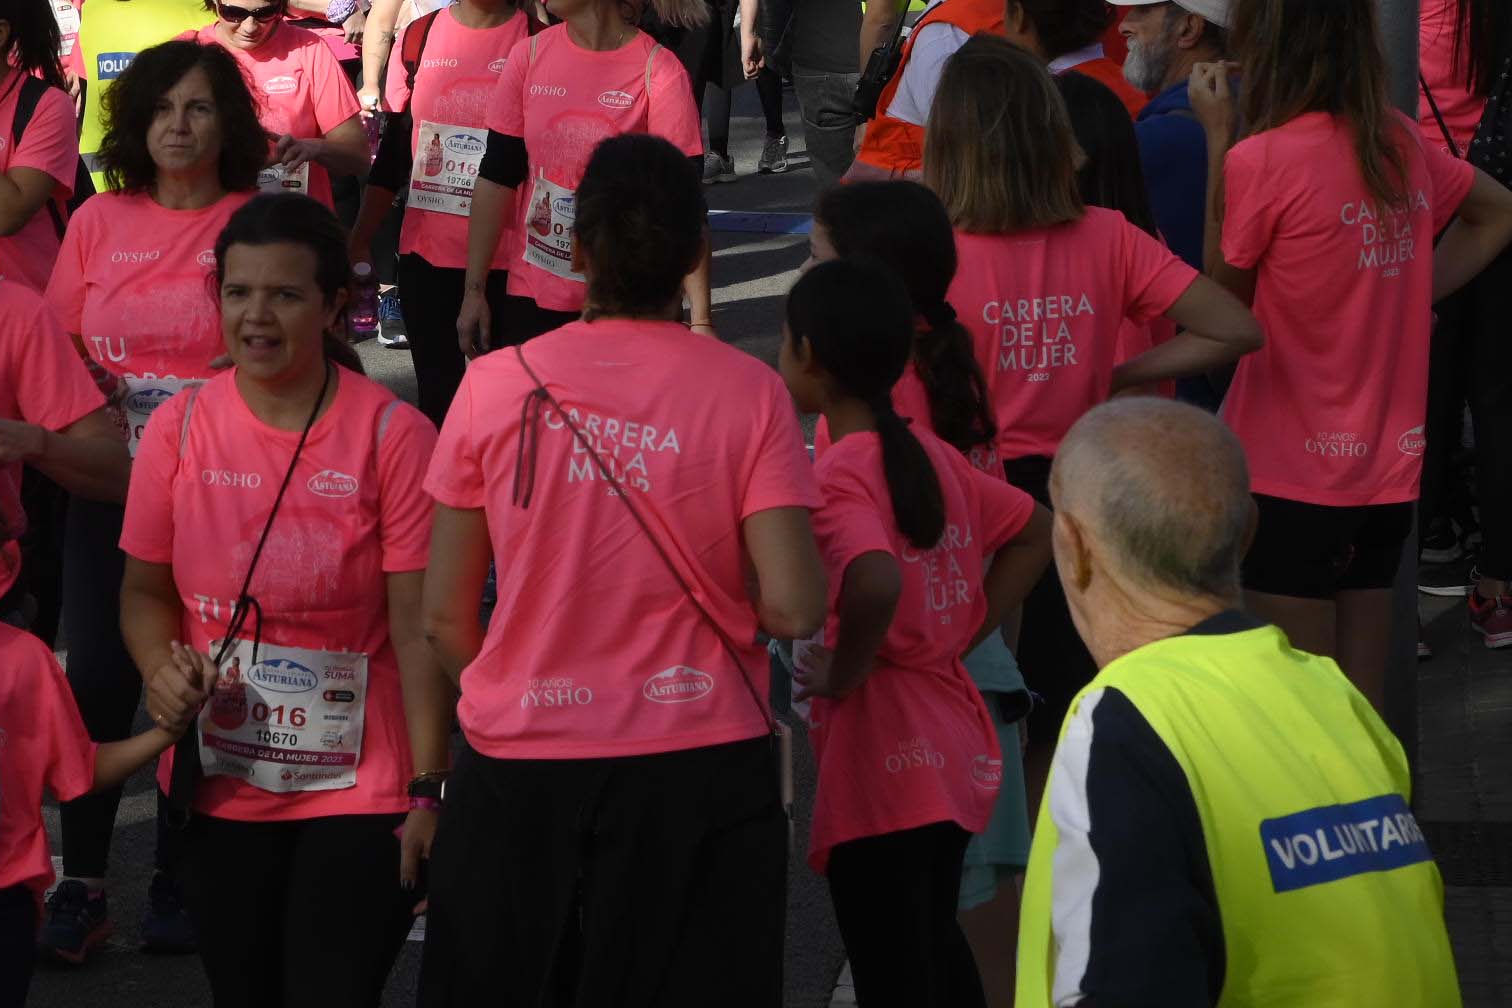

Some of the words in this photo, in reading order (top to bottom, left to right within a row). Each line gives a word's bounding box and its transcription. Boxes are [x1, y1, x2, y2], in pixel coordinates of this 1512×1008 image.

[423, 58, 458, 68] OYSHO
[529, 84, 568, 97] OYSHO
[599, 95, 634, 107] ASTURIANA
[447, 139, 483, 152] ASTURIANA
[445, 159, 477, 176] 016
[1393, 220, 1412, 239] LA
[111, 250, 160, 264] OYSHO
[1357, 238, 1415, 270] MUJER
[982, 292, 1095, 325] CARRERA
[1001, 323, 1034, 347] DE
[1042, 320, 1072, 343] LA
[90, 335, 127, 363] TU
[998, 343, 1079, 371] MUJER
[1027, 372, 1050, 382] 2023
[544, 407, 681, 455] CARRERA
[1304, 438, 1368, 457] OYSHO
[201, 469, 261, 489] OYSHO
[311, 477, 354, 492] ASTURIANA
[253, 668, 313, 688] ASTURIANA
[324, 672, 355, 681] SUMA
[520, 687, 593, 710] OYSHO
[649, 681, 708, 697] ASTURIANA
[251, 702, 307, 727] 016
[255, 729, 298, 746] 10670
[257, 749, 270, 758] DE
[272, 751, 284, 760] LA
[286, 752, 319, 763] MUJER
[320, 755, 344, 764] 2023
[294, 770, 343, 781] Santander
[1270, 812, 1425, 870] VOLUNTARI
